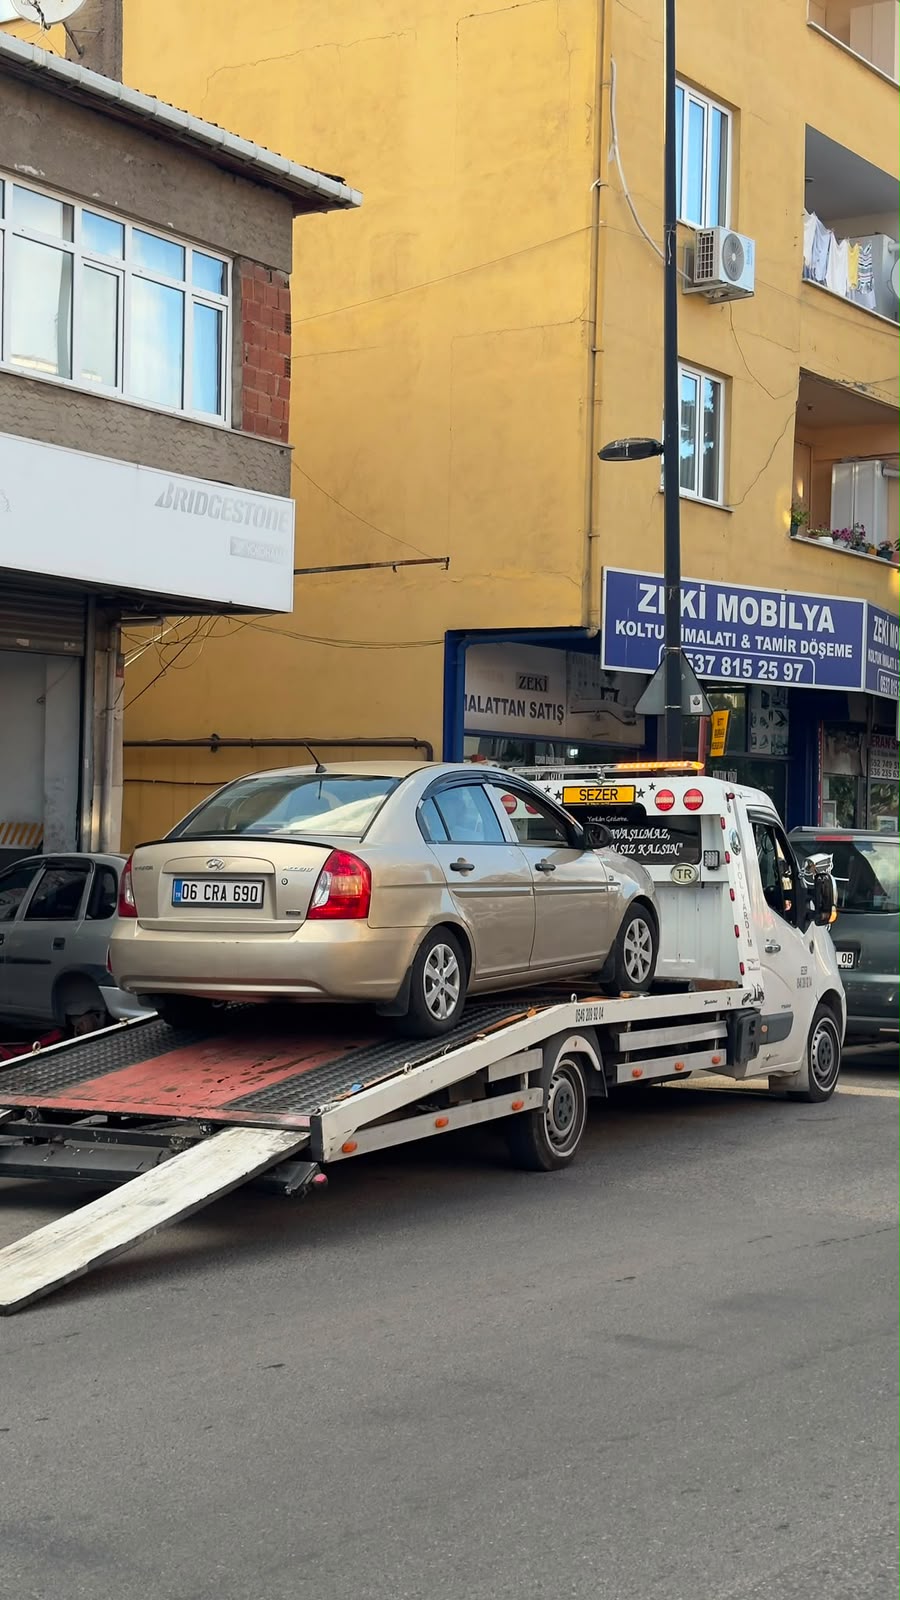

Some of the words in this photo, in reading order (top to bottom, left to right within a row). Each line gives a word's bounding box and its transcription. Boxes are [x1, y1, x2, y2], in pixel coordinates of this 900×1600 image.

[154, 481, 290, 533] BRIDGESTONE
[717, 594, 835, 634] MOBİLYA
[615, 620, 665, 640] KOLTU
[680, 624, 736, 648] İMALATI
[741, 634, 751, 649] &
[755, 635, 797, 654] TAMİR
[800, 639, 853, 660] DÖŞEME
[873, 615, 889, 646] ZEKİ
[890, 622, 900, 652] MO
[685, 653, 716, 674] 537
[720, 657, 753, 679] 815
[757, 661, 779, 681] 25
[783, 663, 805, 682] 97
[518, 675, 549, 692] ZEKİ
[529, 701, 565, 725] SATIŞ
[579, 788, 618, 801] SEZER
[610, 828, 671, 841] AVAŞILMAZ,
[676, 868, 692, 880] TR
[182, 884, 197, 900] 06
[203, 885, 227, 901] CRA
[233, 886, 258, 902] 690
[841, 952, 853, 964] 08
